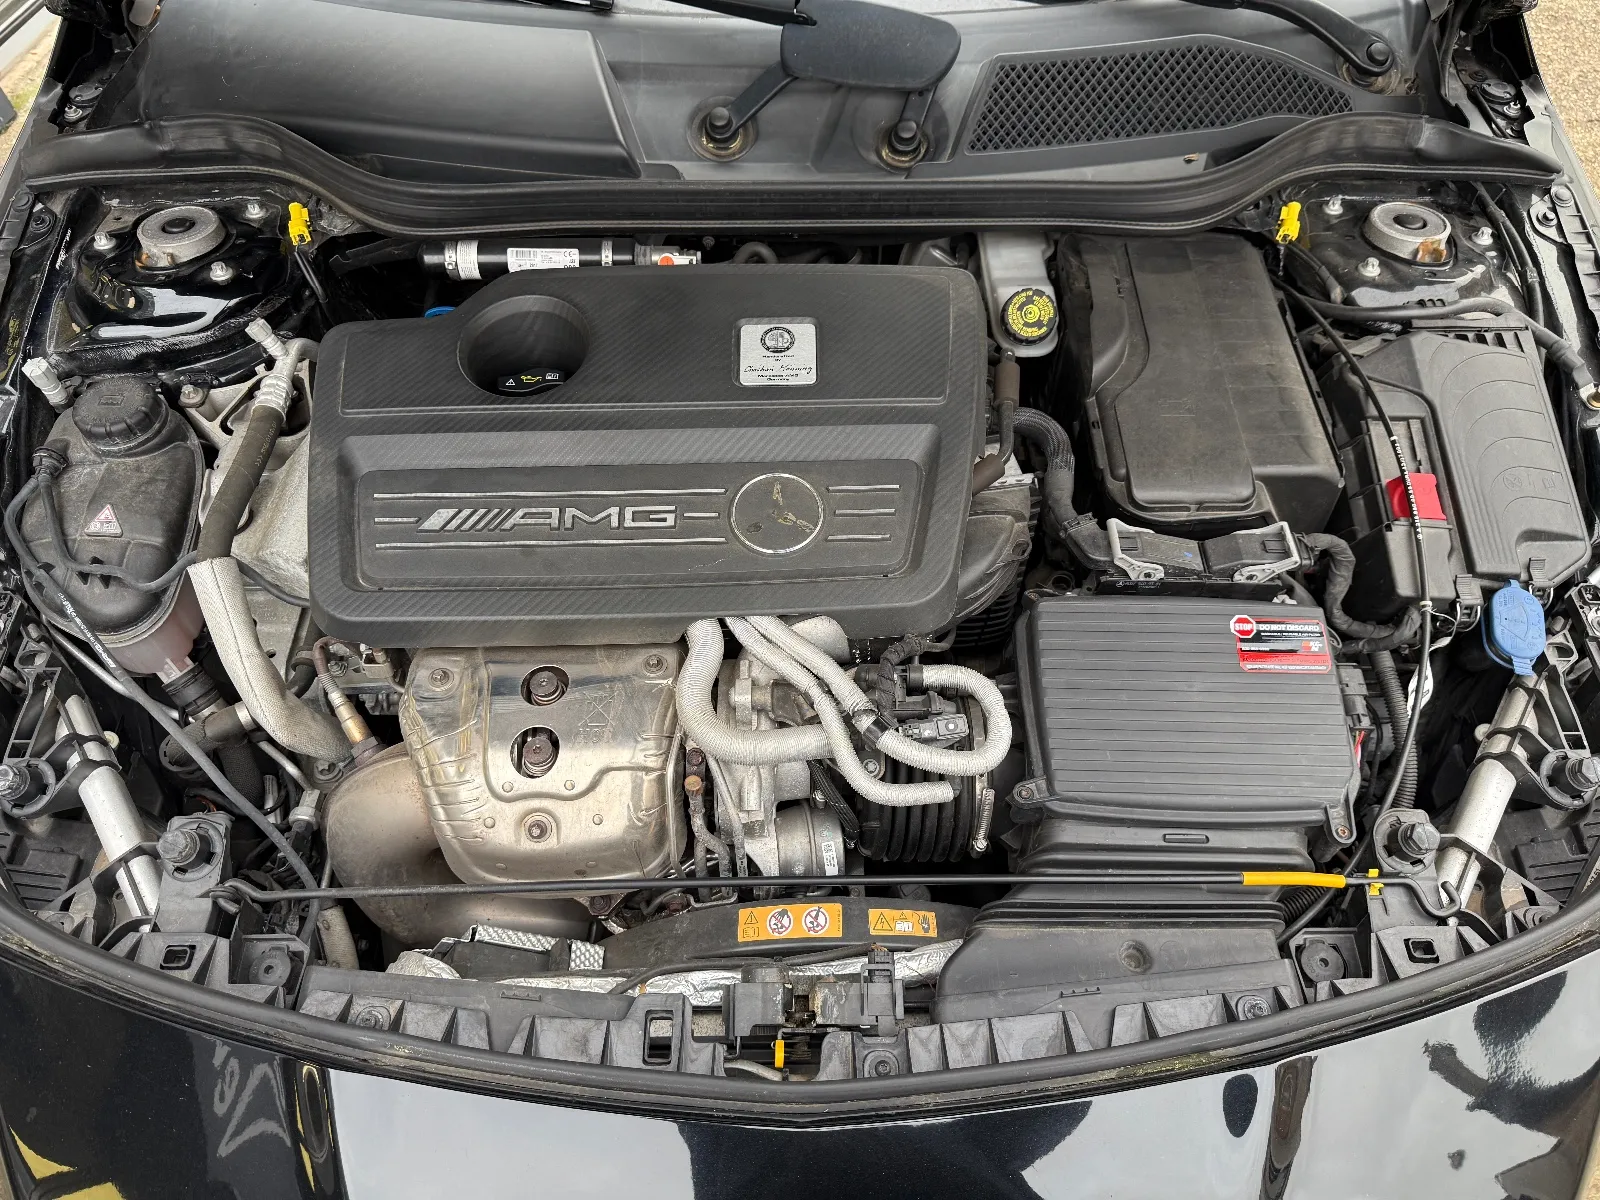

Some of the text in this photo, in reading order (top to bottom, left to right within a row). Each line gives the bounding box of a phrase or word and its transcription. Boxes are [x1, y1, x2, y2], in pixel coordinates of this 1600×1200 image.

[500, 505, 677, 532] AMG
[1234, 623, 1253, 631] STOP
[1287, 624, 1320, 632] DISCARD
